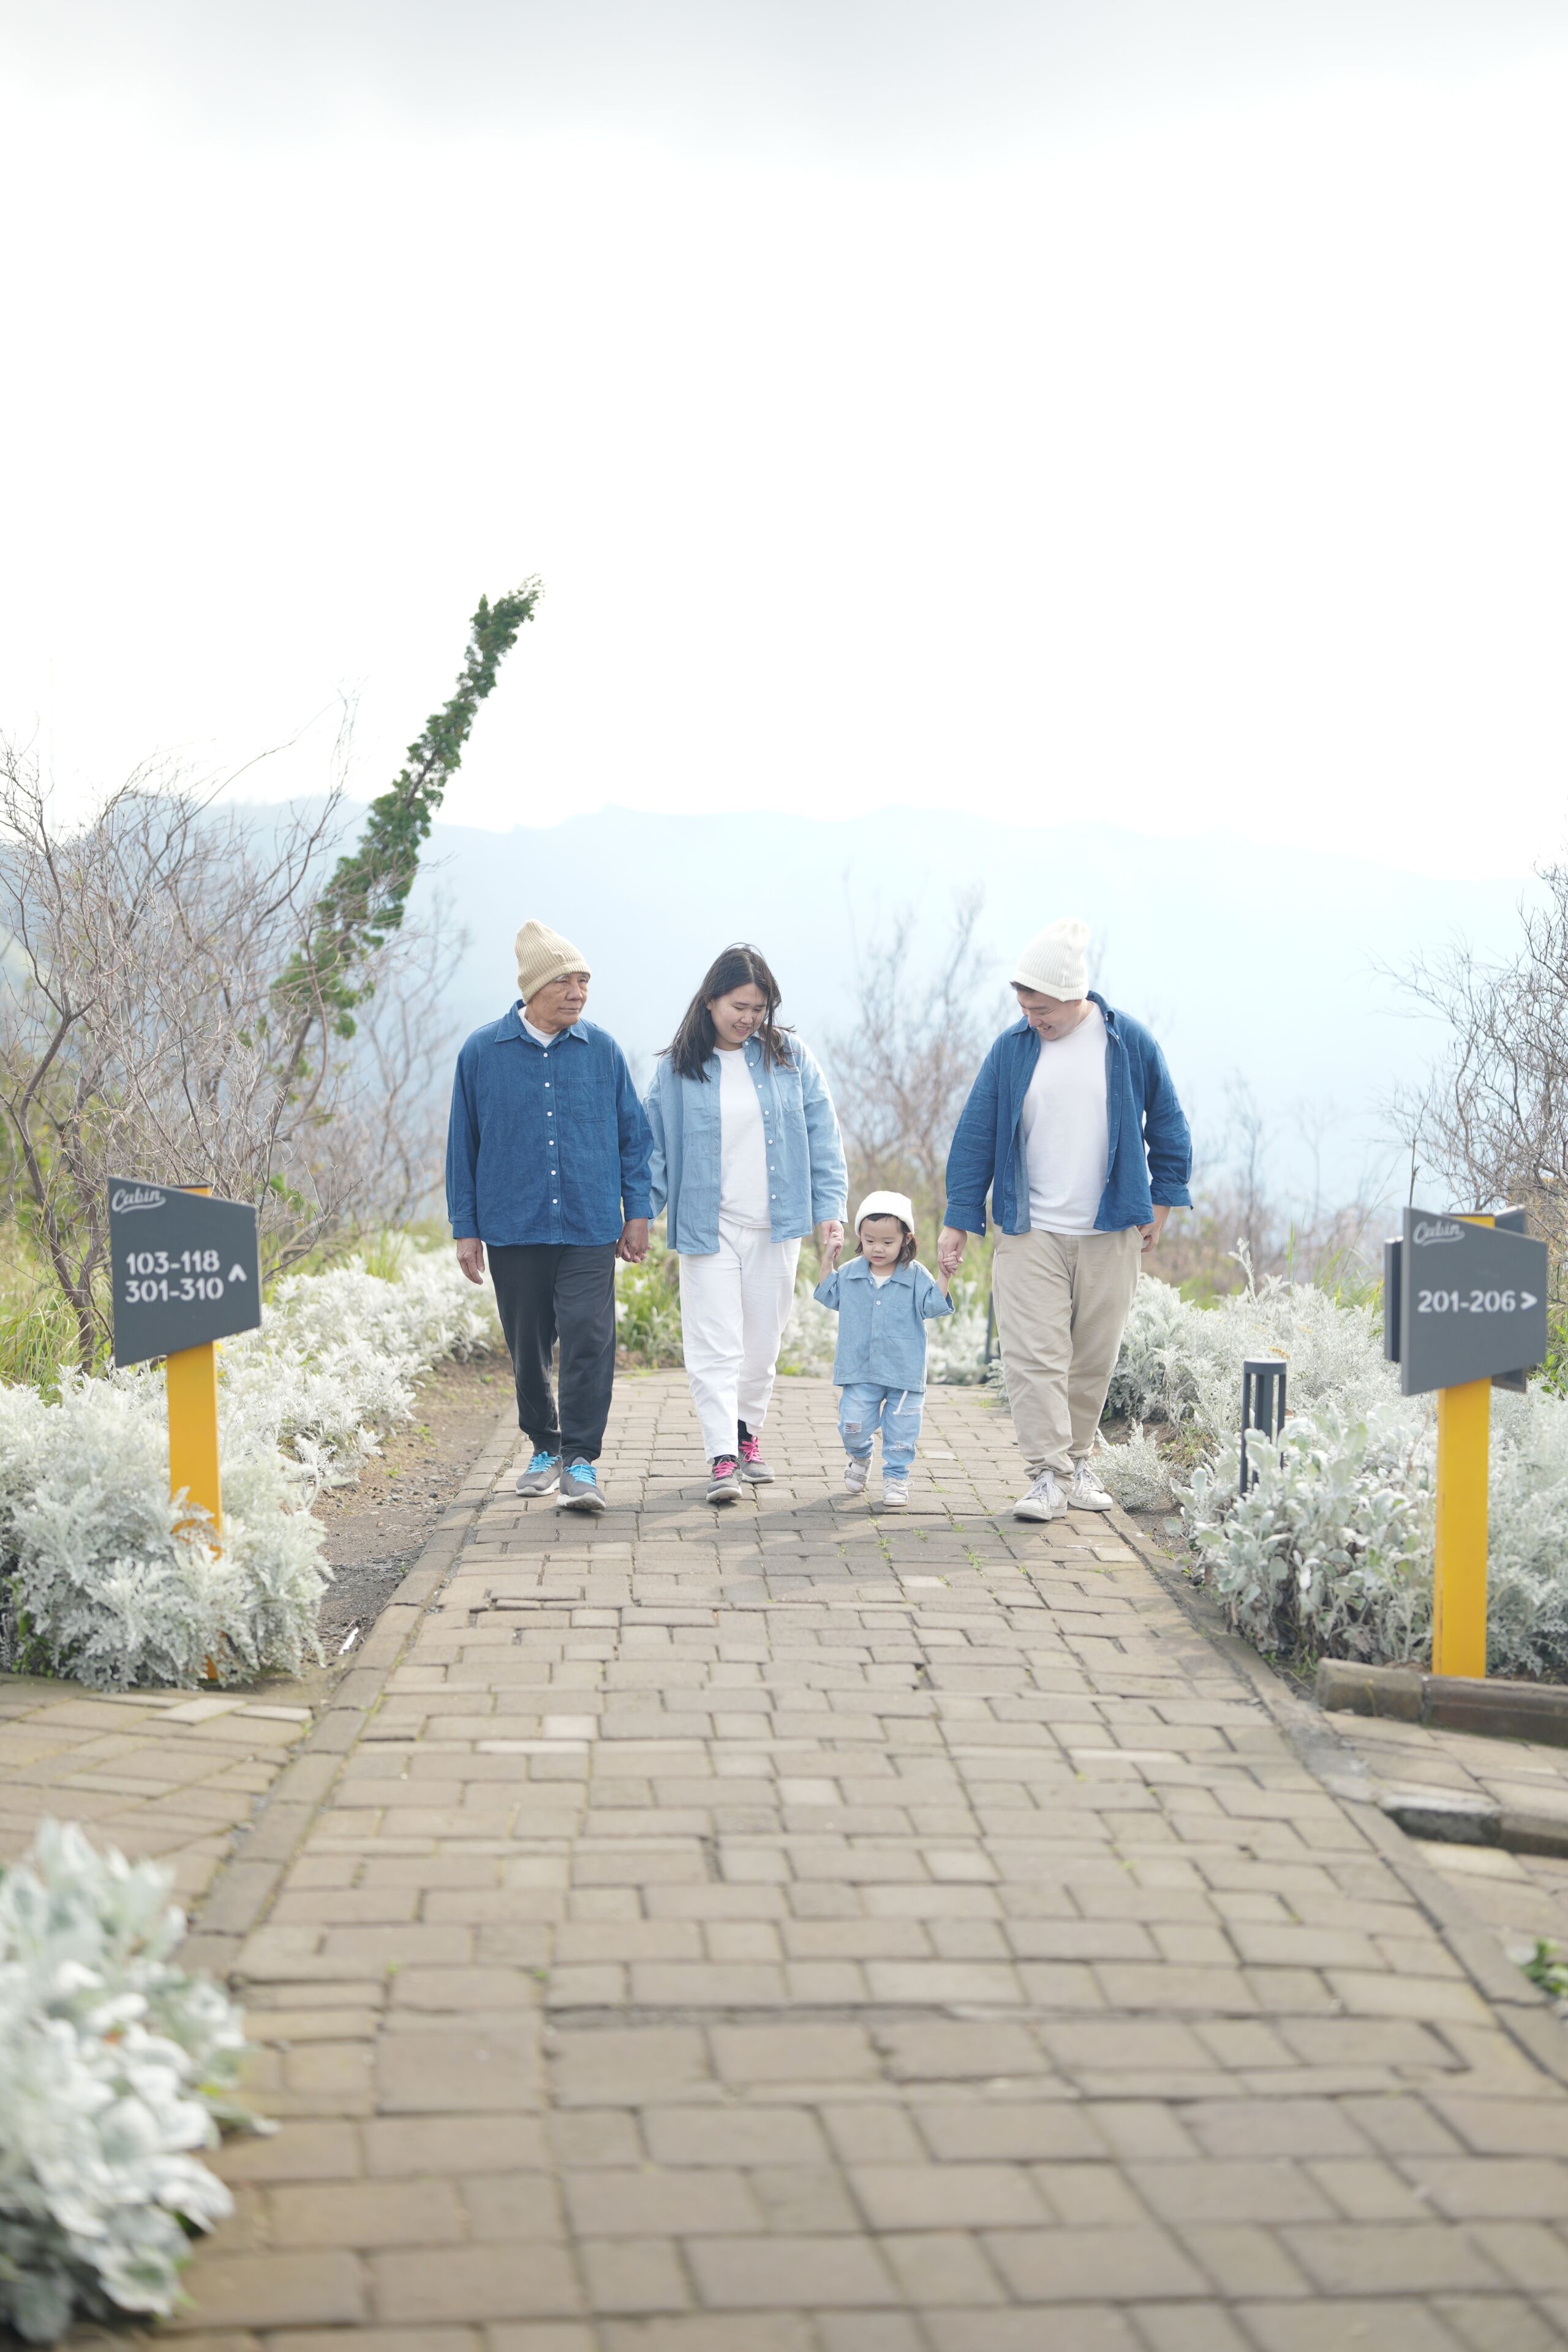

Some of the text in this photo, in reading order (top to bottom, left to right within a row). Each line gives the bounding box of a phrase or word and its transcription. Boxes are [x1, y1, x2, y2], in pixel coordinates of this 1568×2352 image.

[111, 1187, 166, 1213] Cabin
[1413, 1221, 1465, 1246] Cabin
[126, 1250, 220, 1275] 103-118
[125, 1278, 224, 1303] 301-310
[1417, 1290, 1516, 1313] 201-206
